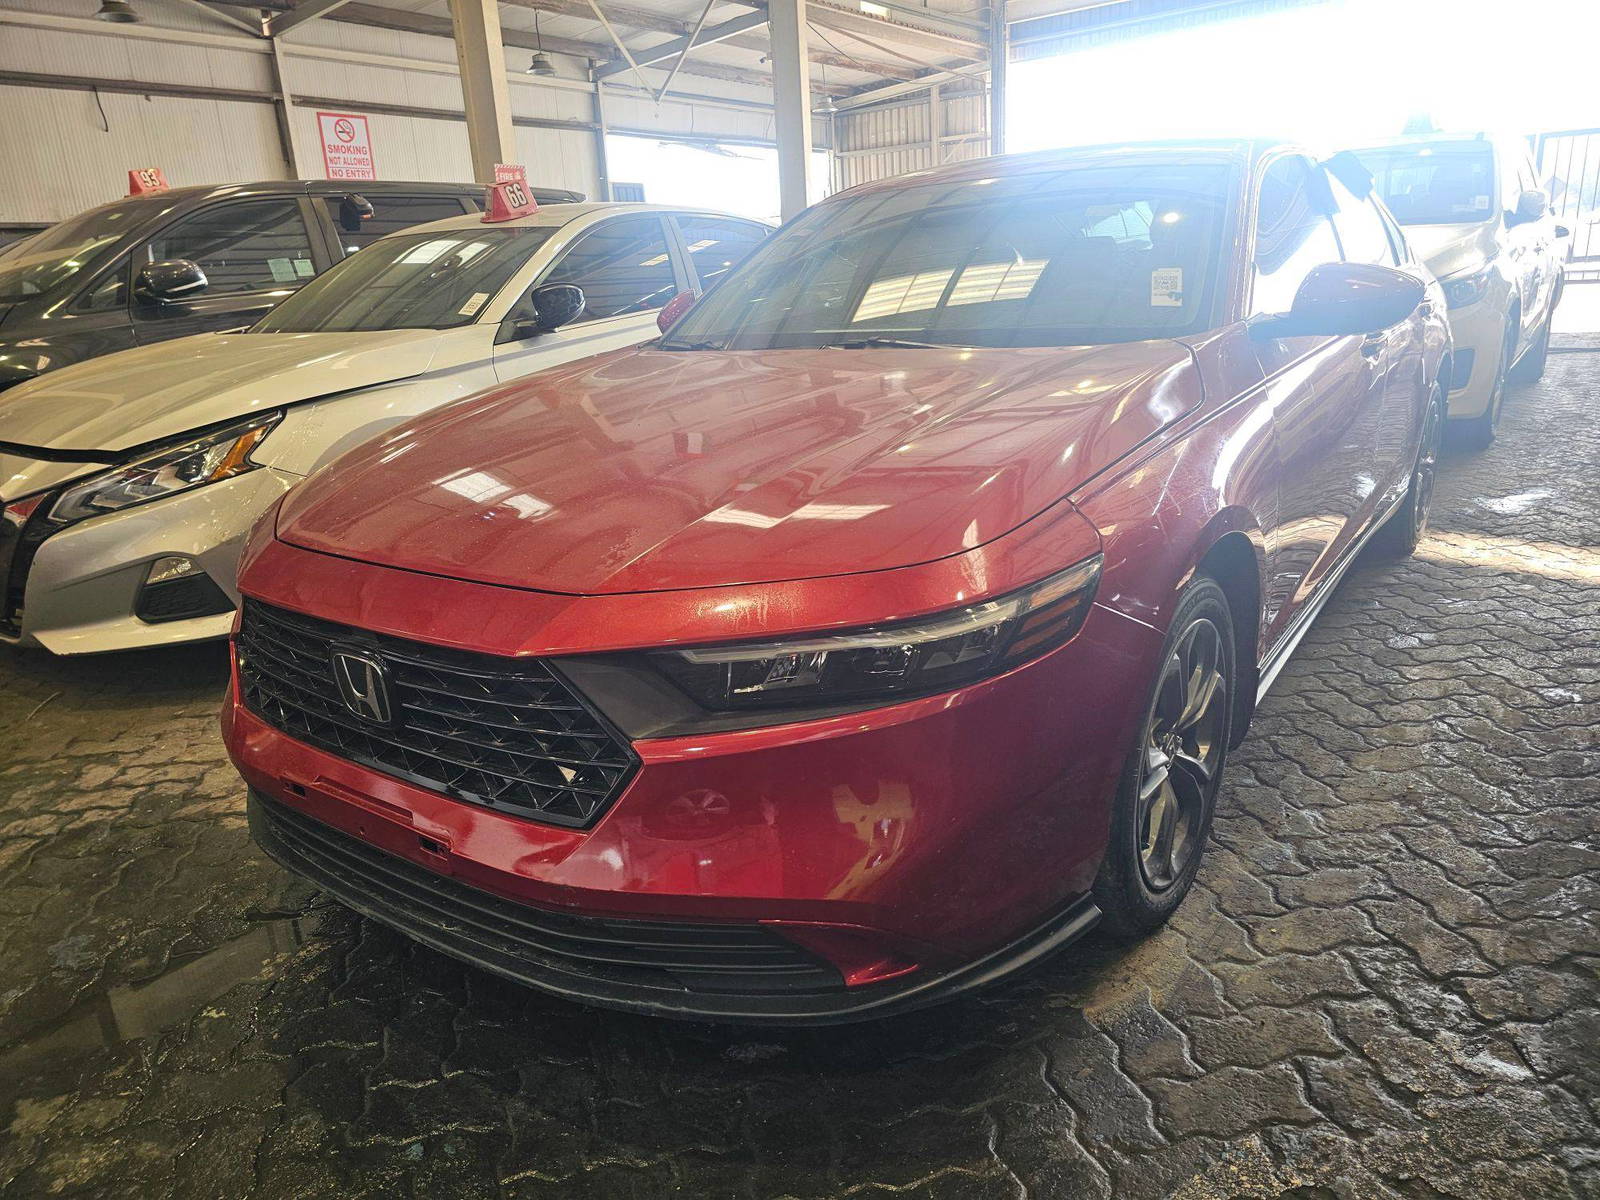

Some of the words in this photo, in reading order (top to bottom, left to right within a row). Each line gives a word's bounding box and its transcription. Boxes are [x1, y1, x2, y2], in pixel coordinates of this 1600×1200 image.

[328, 144, 368, 155] SMOKING
[329, 156, 341, 165] NOT
[344, 157, 370, 166] ALLOWED
[140, 169, 160, 187] 93
[332, 169, 343, 177] NO
[346, 169, 371, 178] ENTRY
[505, 183, 527, 207] 66
